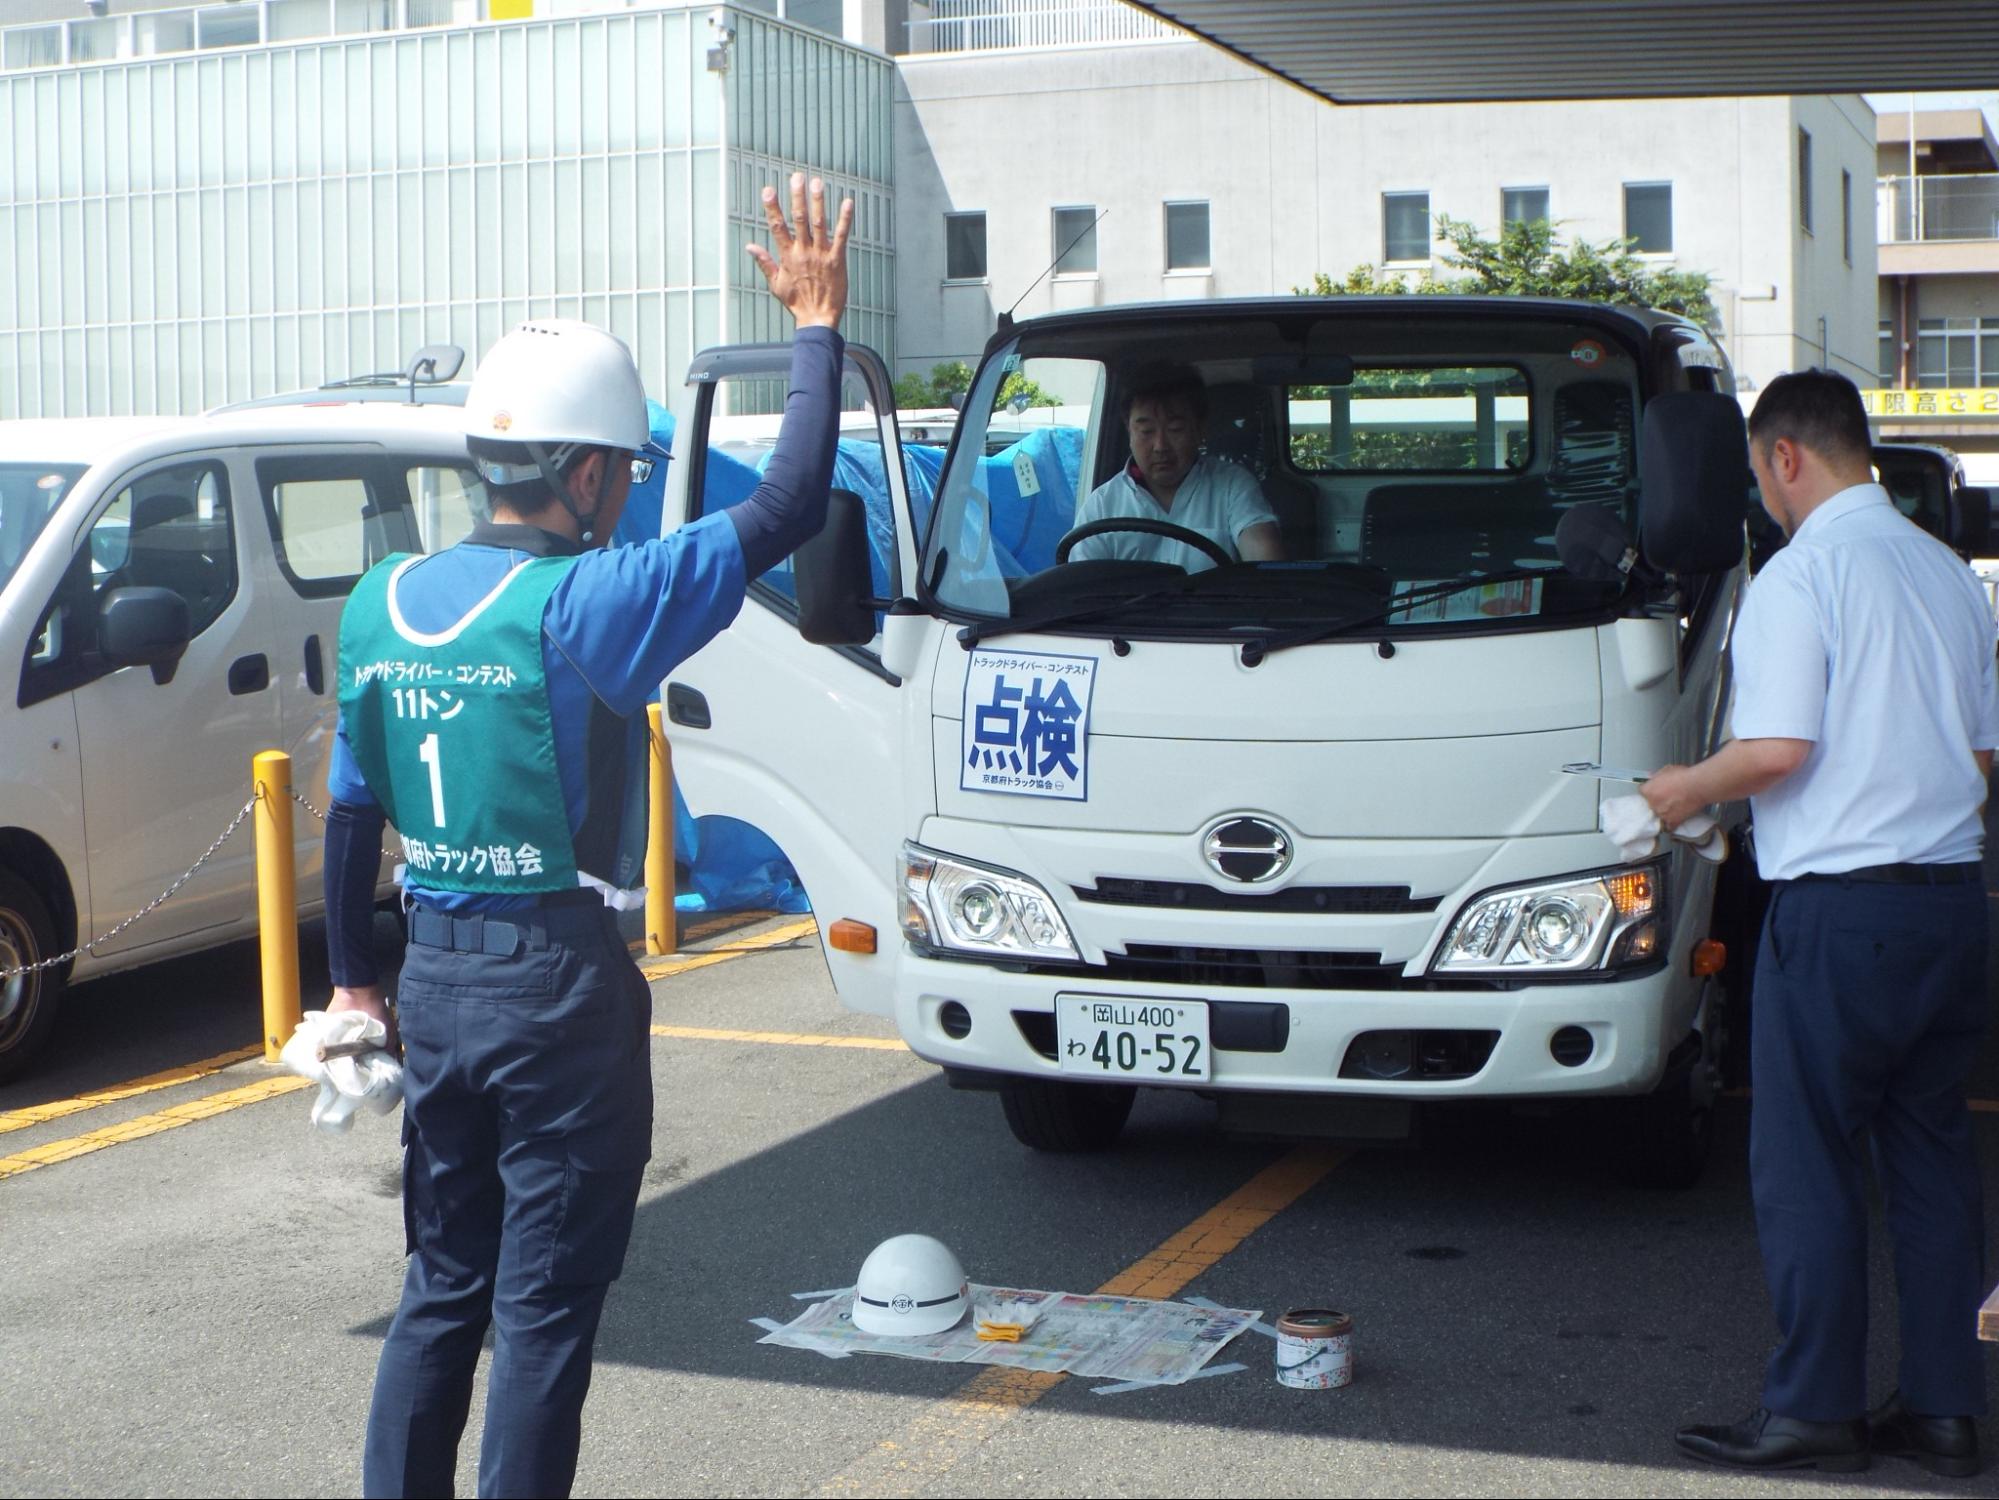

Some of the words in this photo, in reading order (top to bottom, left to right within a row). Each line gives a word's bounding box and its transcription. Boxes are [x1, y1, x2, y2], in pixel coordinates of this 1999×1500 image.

[392, 688, 465, 720] 11トン
[968, 674, 1083, 781] 点検
[419, 733, 446, 828] 1
[982, 774, 1053, 790] 京都府トラック協会
[1067, 1038, 1086, 1057] わ
[1092, 1030, 1202, 1075] 40-52
